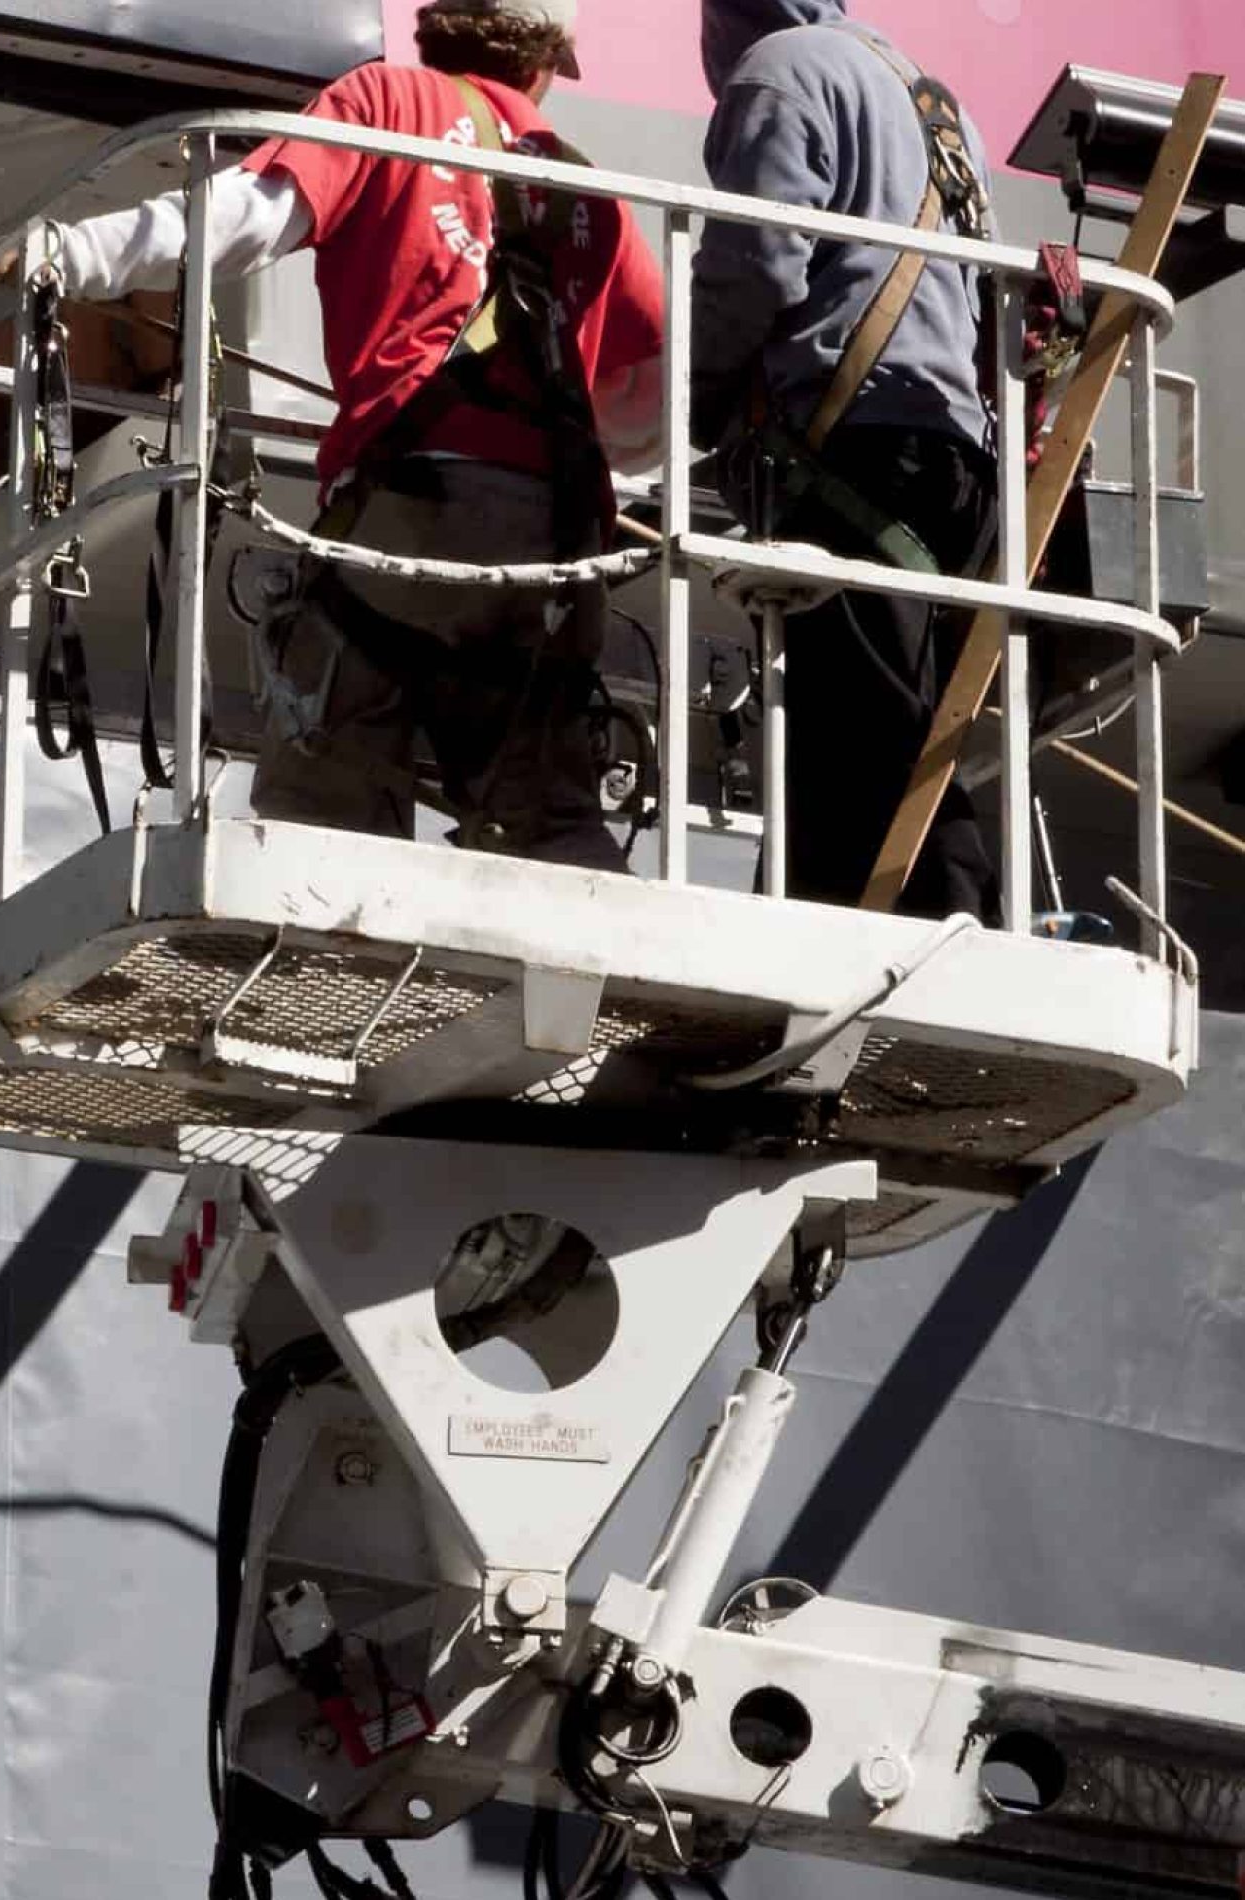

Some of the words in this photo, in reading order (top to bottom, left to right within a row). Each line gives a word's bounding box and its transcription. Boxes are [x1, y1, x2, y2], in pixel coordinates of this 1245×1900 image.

[556, 1426, 595, 1441] MUST
[482, 1436, 524, 1450] WASH
[530, 1438, 578, 1453] HANDS
